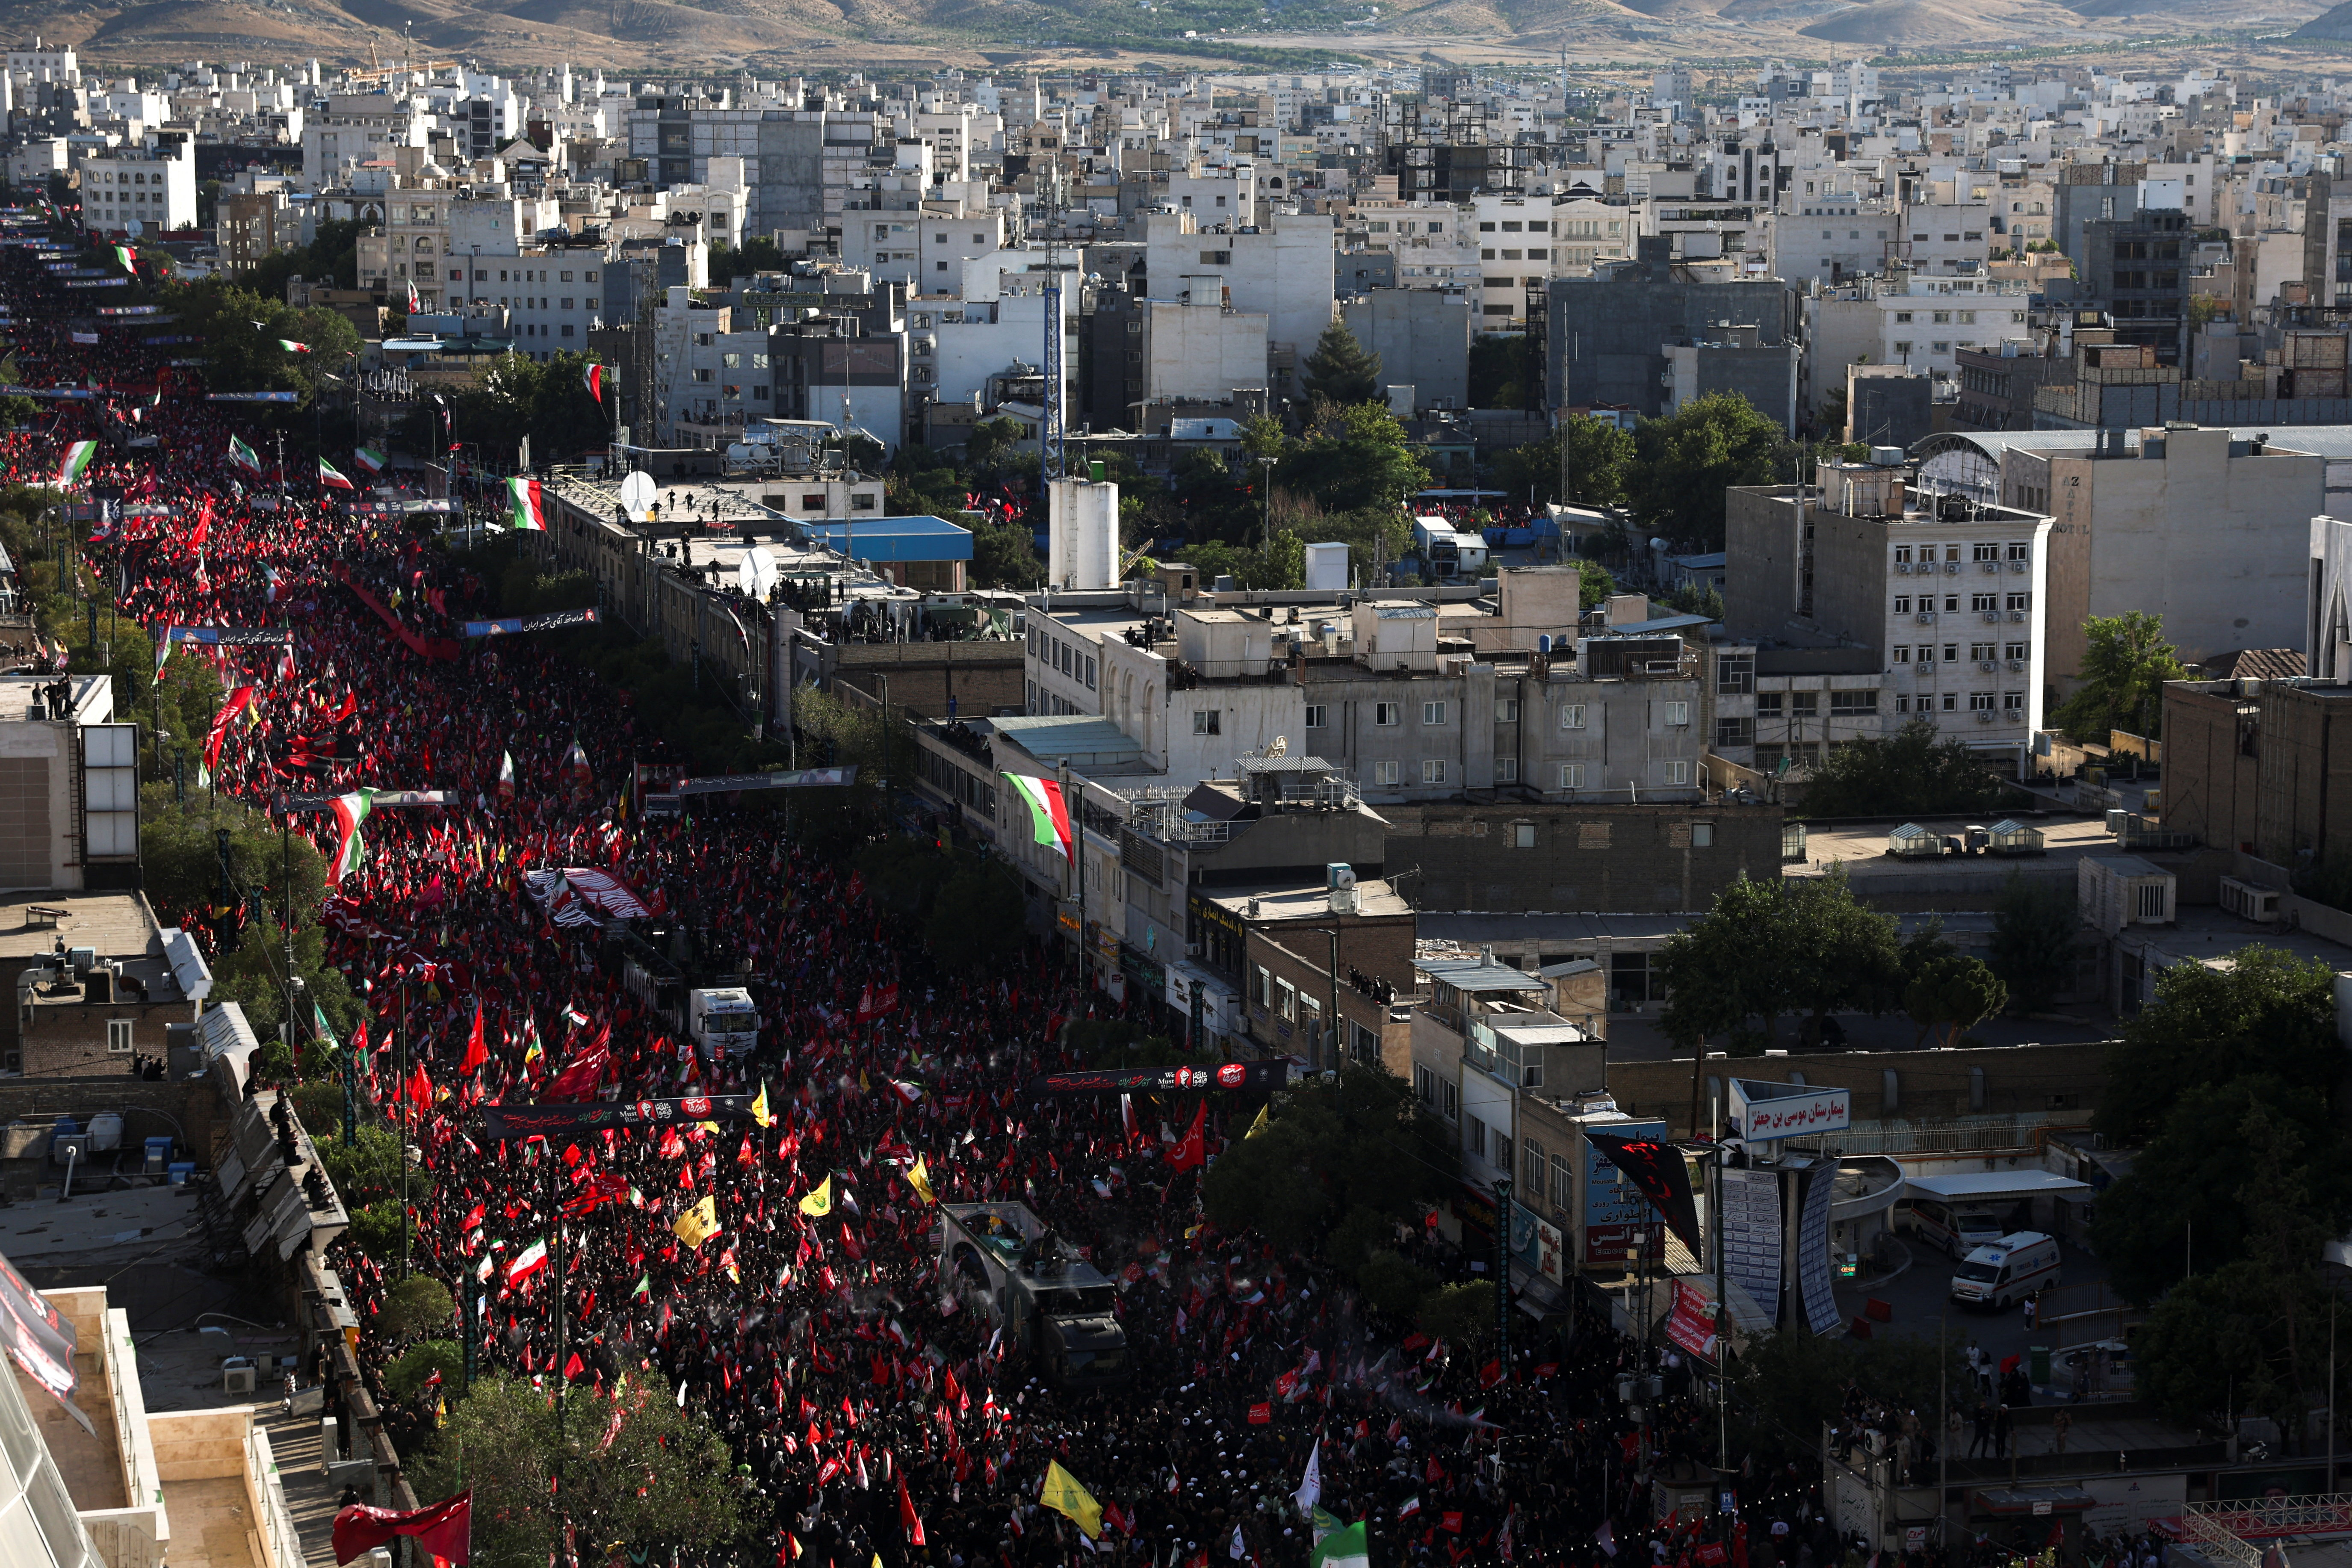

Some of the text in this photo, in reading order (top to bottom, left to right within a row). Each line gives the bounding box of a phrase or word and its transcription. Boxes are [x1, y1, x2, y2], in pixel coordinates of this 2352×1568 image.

[2062, 476, 2079, 486] AZ
[2051, 523, 2089, 534] HOTL
[523, 613, 584, 632] خداحافظ آقای شهید ایران
[219, 630, 284, 644] خداحافظ آقای شهید ایران
[1118, 1077, 1132, 1087] ایران
[578, 1111, 591, 1123] ایران
[1808, 1100, 1844, 1123] بیمارستان
[1752, 1110, 1770, 1132] جعفر
[1773, 1112, 1782, 1128] بن
[1784, 1109, 1806, 1127] موسی
[1753, 1215, 1774, 1223] داروخانه
[1682, 1285, 1687, 1295] We
[1675, 1320, 1686, 1329] Trump
[1723, 1494, 1731, 1503] H
[1908, 1527, 1924, 1538] خروج
